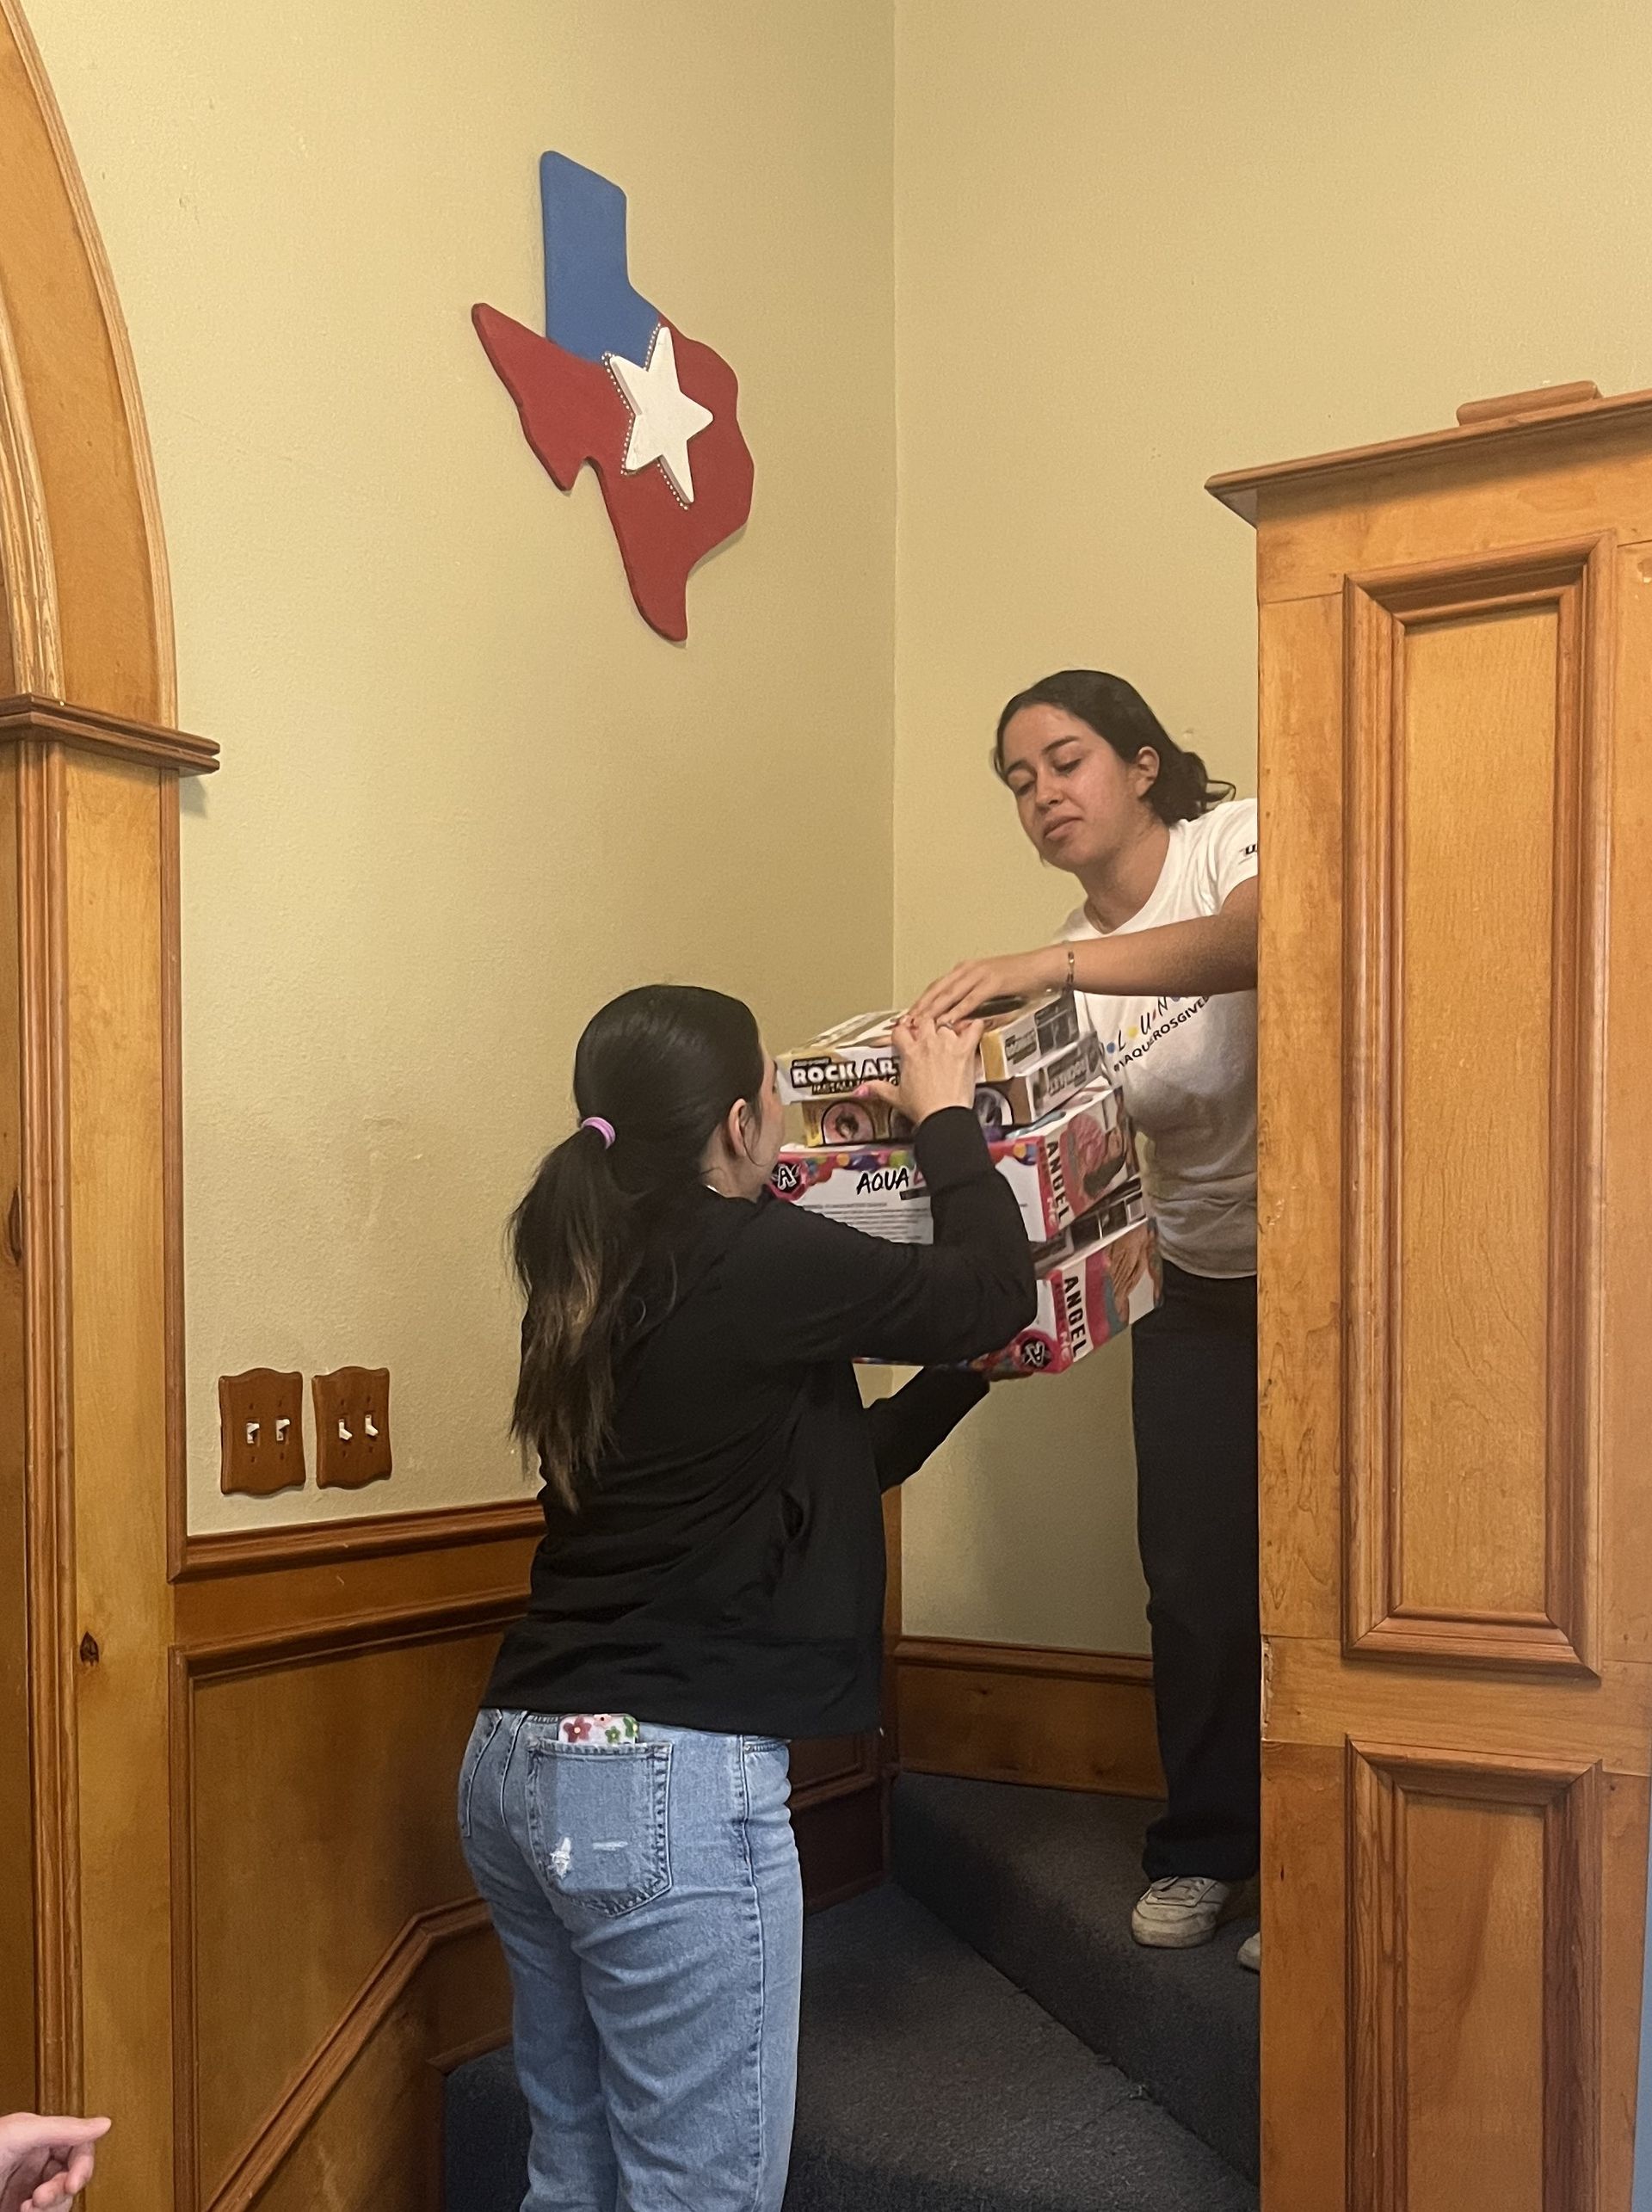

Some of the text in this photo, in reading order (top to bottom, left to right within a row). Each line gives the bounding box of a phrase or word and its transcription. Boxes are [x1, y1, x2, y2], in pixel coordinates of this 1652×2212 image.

[792, 1062, 857, 1087] ROCK
[857, 1168, 909, 1195] AQUA
[1046, 1141, 1069, 1221] ANGEL
[1064, 1276, 1087, 1358] ANGEL
